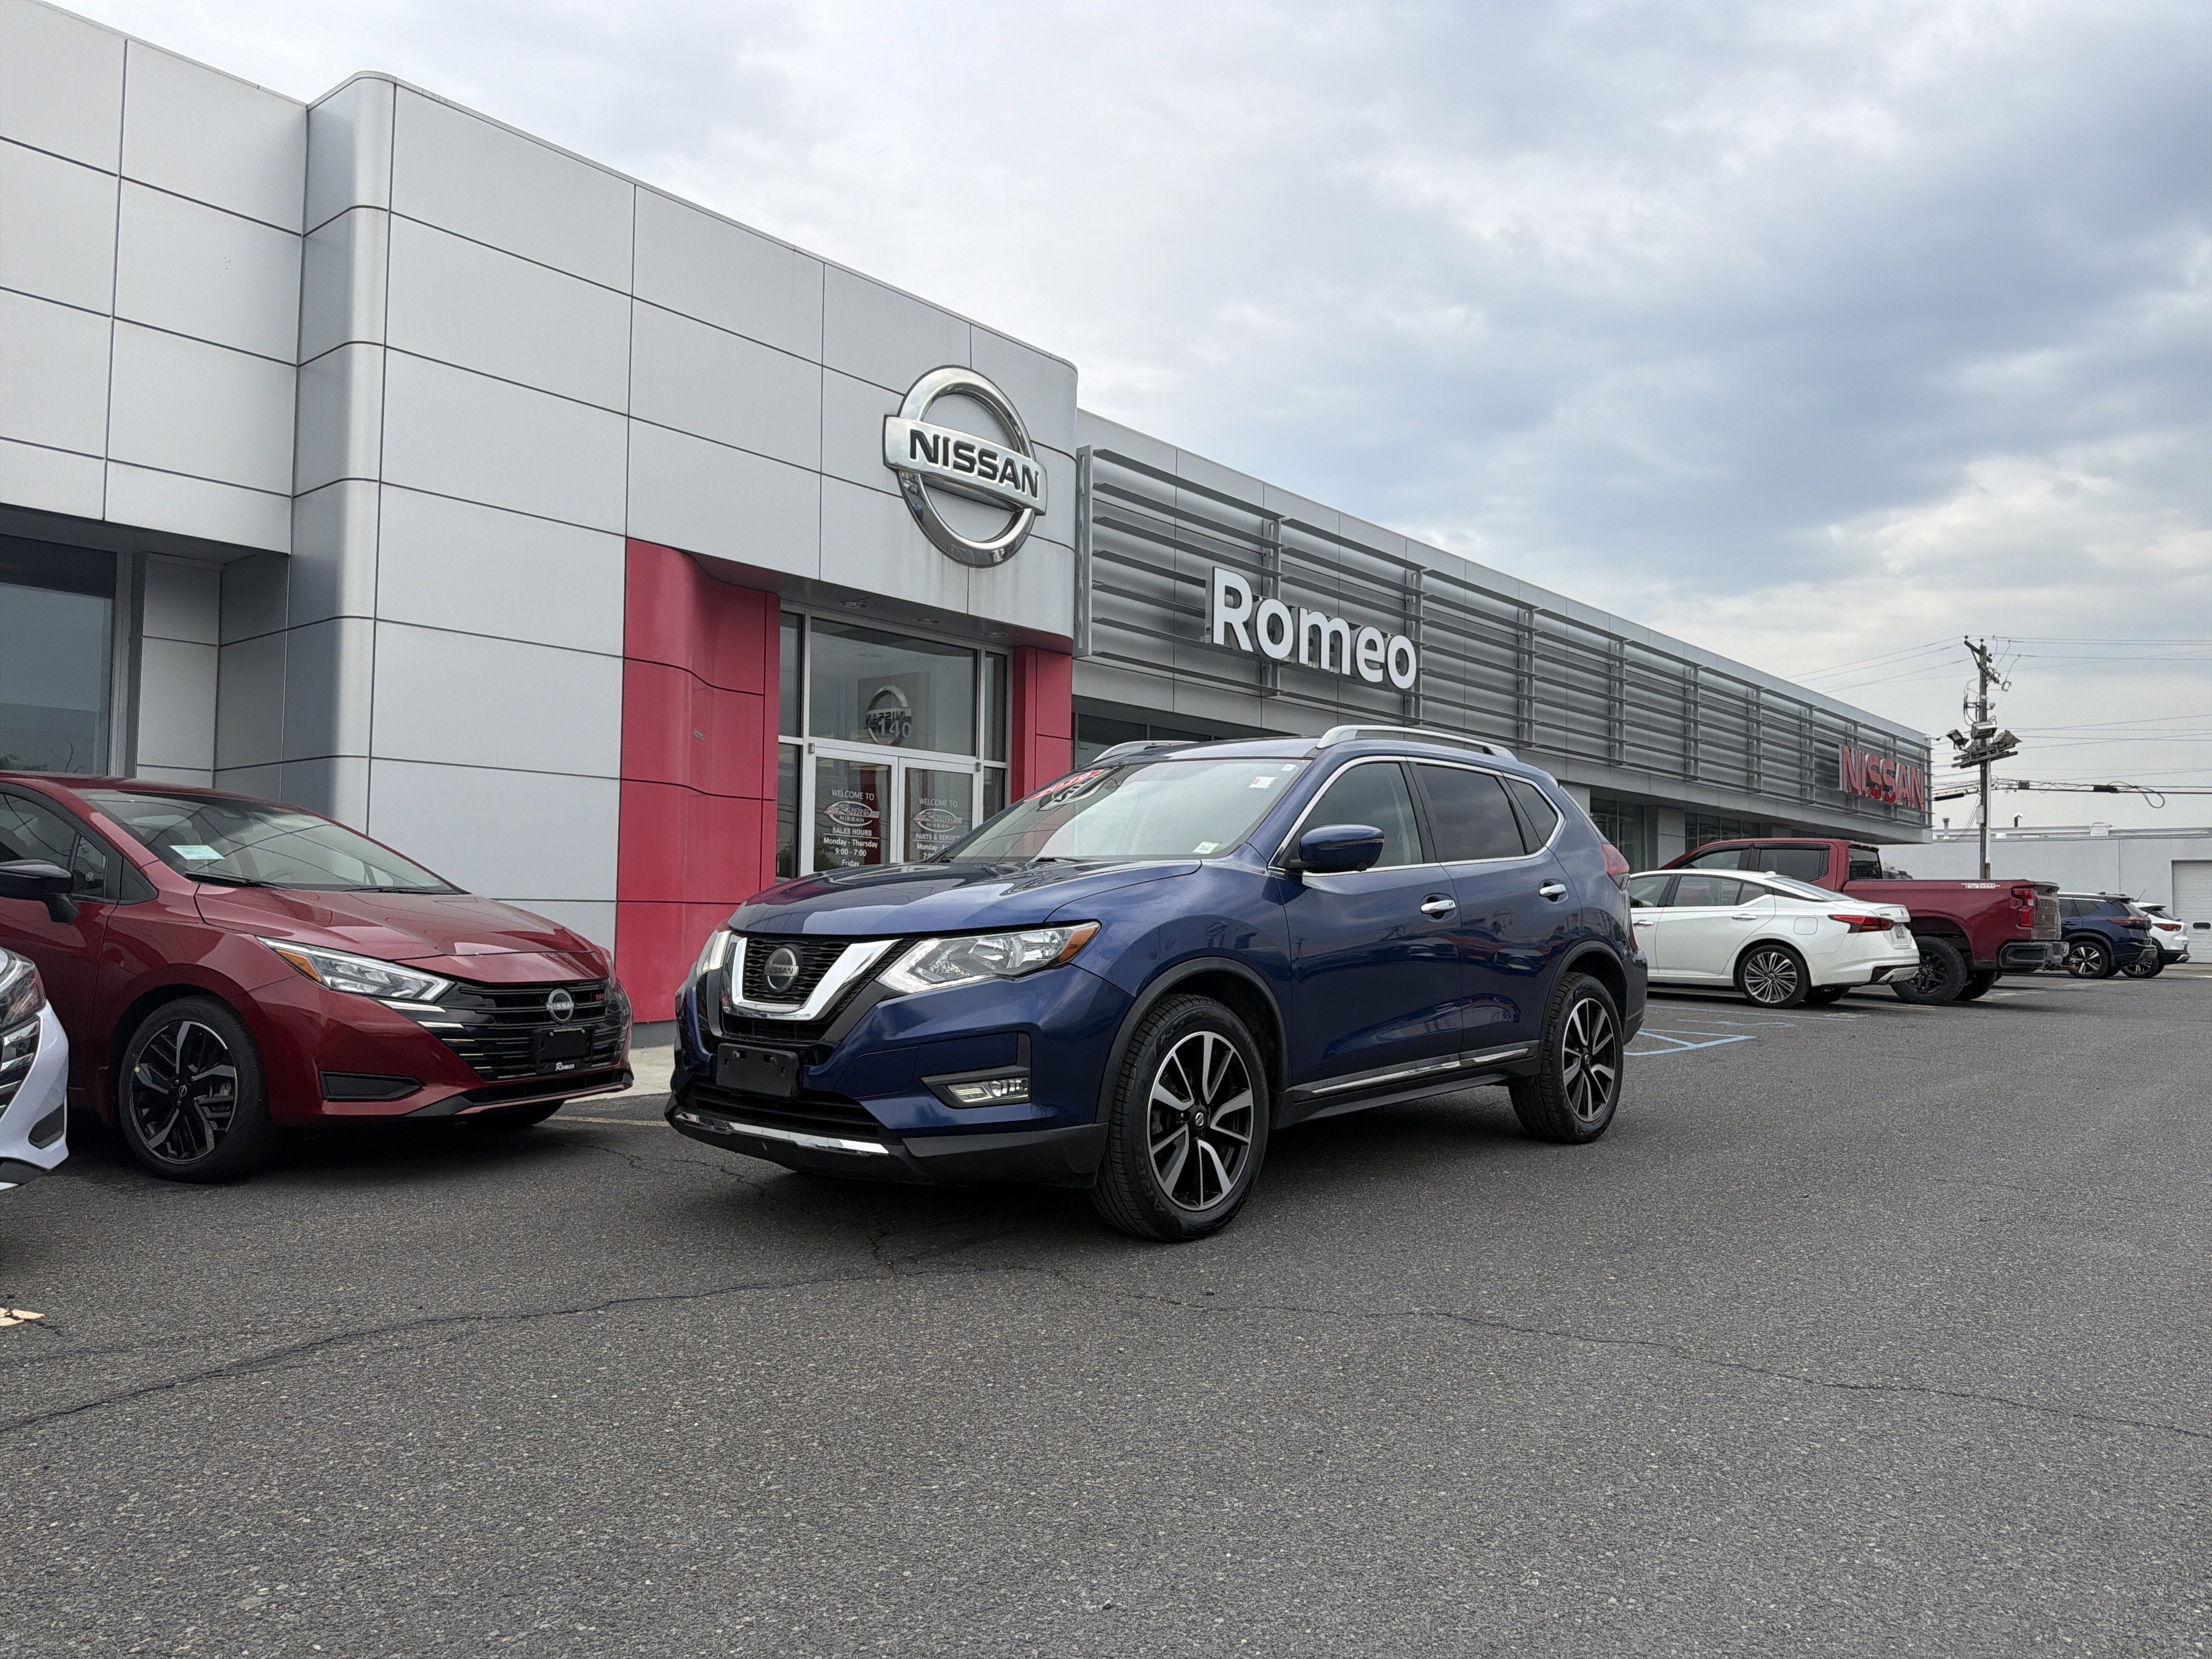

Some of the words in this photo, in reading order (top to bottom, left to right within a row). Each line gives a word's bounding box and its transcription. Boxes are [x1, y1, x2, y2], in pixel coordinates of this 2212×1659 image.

[910, 428, 1039, 499] NISSAN
[1212, 566, 1417, 689] Romeo
[878, 719, 911, 738] 140
[1840, 746, 1925, 811] NISSAN
[831, 789, 864, 800] WELCOME
[865, 792, 874, 801] TO
[919, 798, 948, 806] WELCOME
[836, 802, 871, 816] Romeo
[922, 810, 955, 822] Romeo
[823, 837, 847, 847] Monday
[851, 839, 878, 849] Thursday
[917, 843, 938, 851] Monday
[768, 966, 794, 974] NISSAN
[555, 1062, 574, 1071] Romeo
